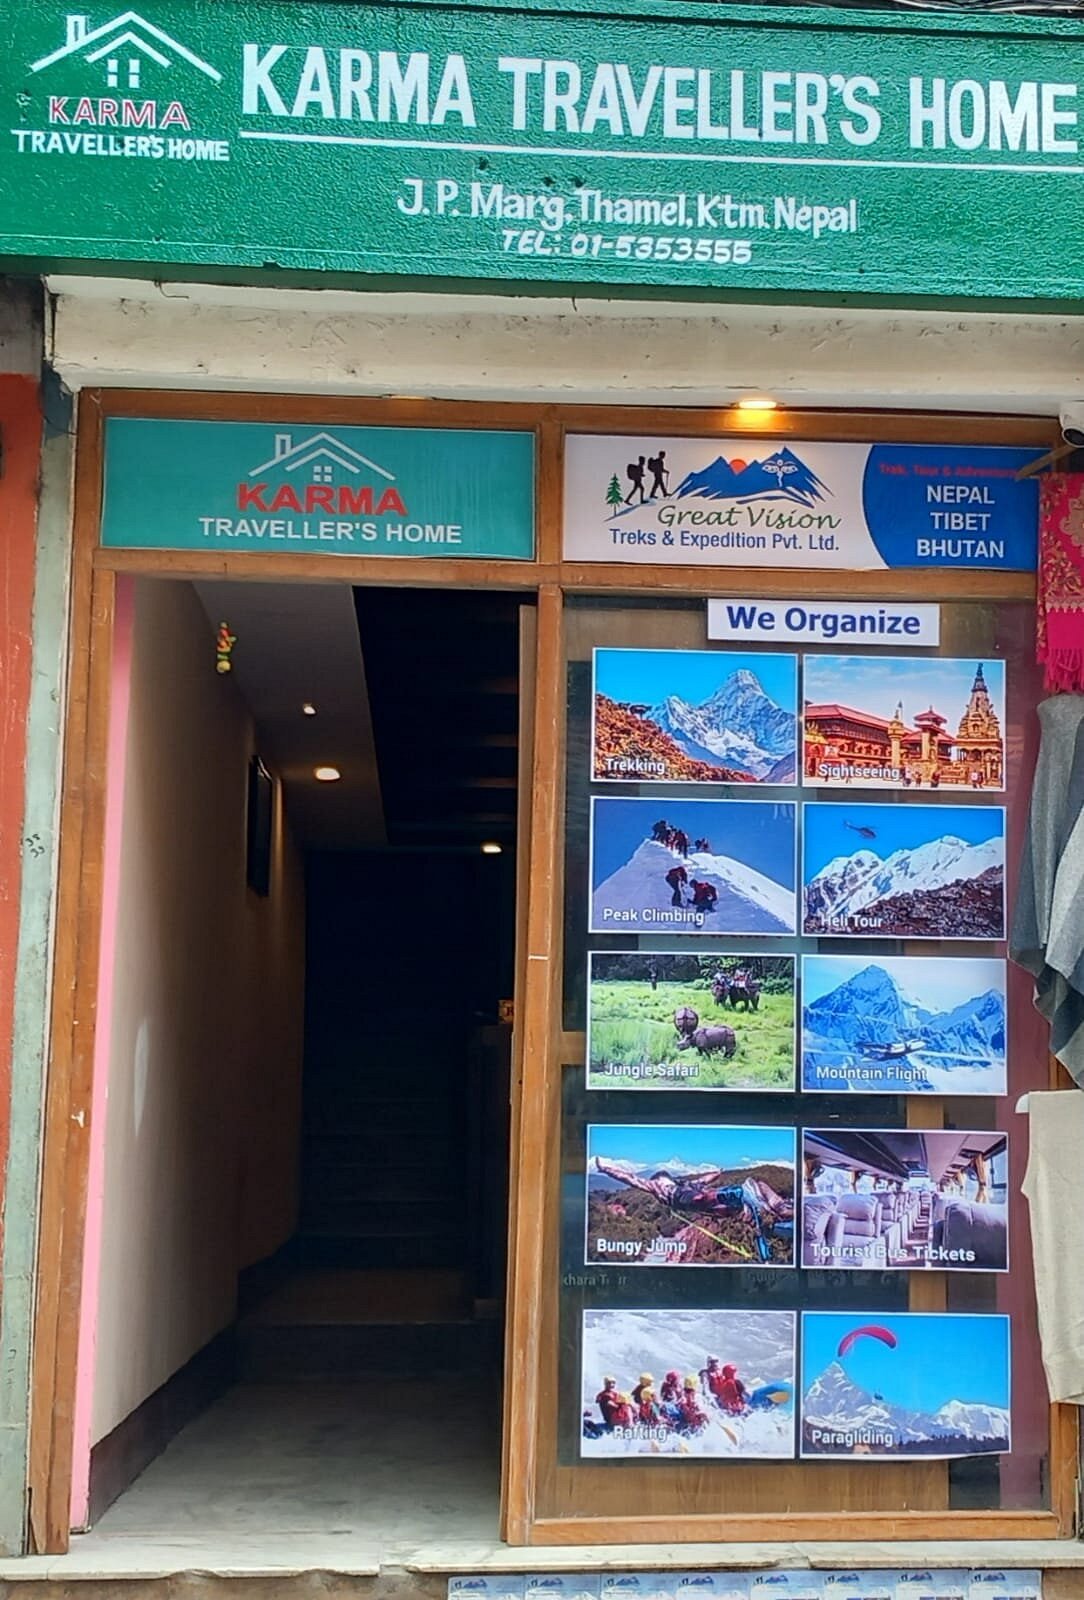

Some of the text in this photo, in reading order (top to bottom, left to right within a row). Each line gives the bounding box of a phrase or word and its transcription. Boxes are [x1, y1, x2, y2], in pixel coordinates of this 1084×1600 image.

[242, 43, 477, 127] KARMA
[909, 76, 1078, 154] HOME
[48, 96, 191, 131] KARMA
[166, 137, 230, 161] HOME
[774, 196, 858, 239] Nepal
[502, 229, 752, 264] TEL: 01-5353555
[238, 483, 407, 516] KARMA
[926, 485, 996, 505] NEPAL
[658, 505, 842, 530] Great Vision
[930, 512, 991, 532] TIBET
[199, 517, 463, 544] TRAVELLER'S HOME
[609, 528, 657, 546] Treks
[662, 530, 675, 547] &
[772, 535, 803, 550] Pvt.
[808, 535, 840, 551] Ltd.
[916, 538, 1004, 559] BHUTAN
[727, 606, 921, 639] We Organize
[605, 758, 665, 775] Trekking
[818, 763, 901, 781] Sightseeing
[602, 908, 705, 927] Peak Climbing
[821, 913, 883, 928] Heli Tour
[604, 1063, 700, 1079] Jungle Safari
[816, 1066, 926, 1083] Mountain Flight
[596, 1238, 687, 1256] Bungy Jump
[810, 1243, 976, 1262] Tourist Bus Tickets
[613, 1426, 668, 1443] Rafting
[811, 1430, 894, 1448] Paragliding
